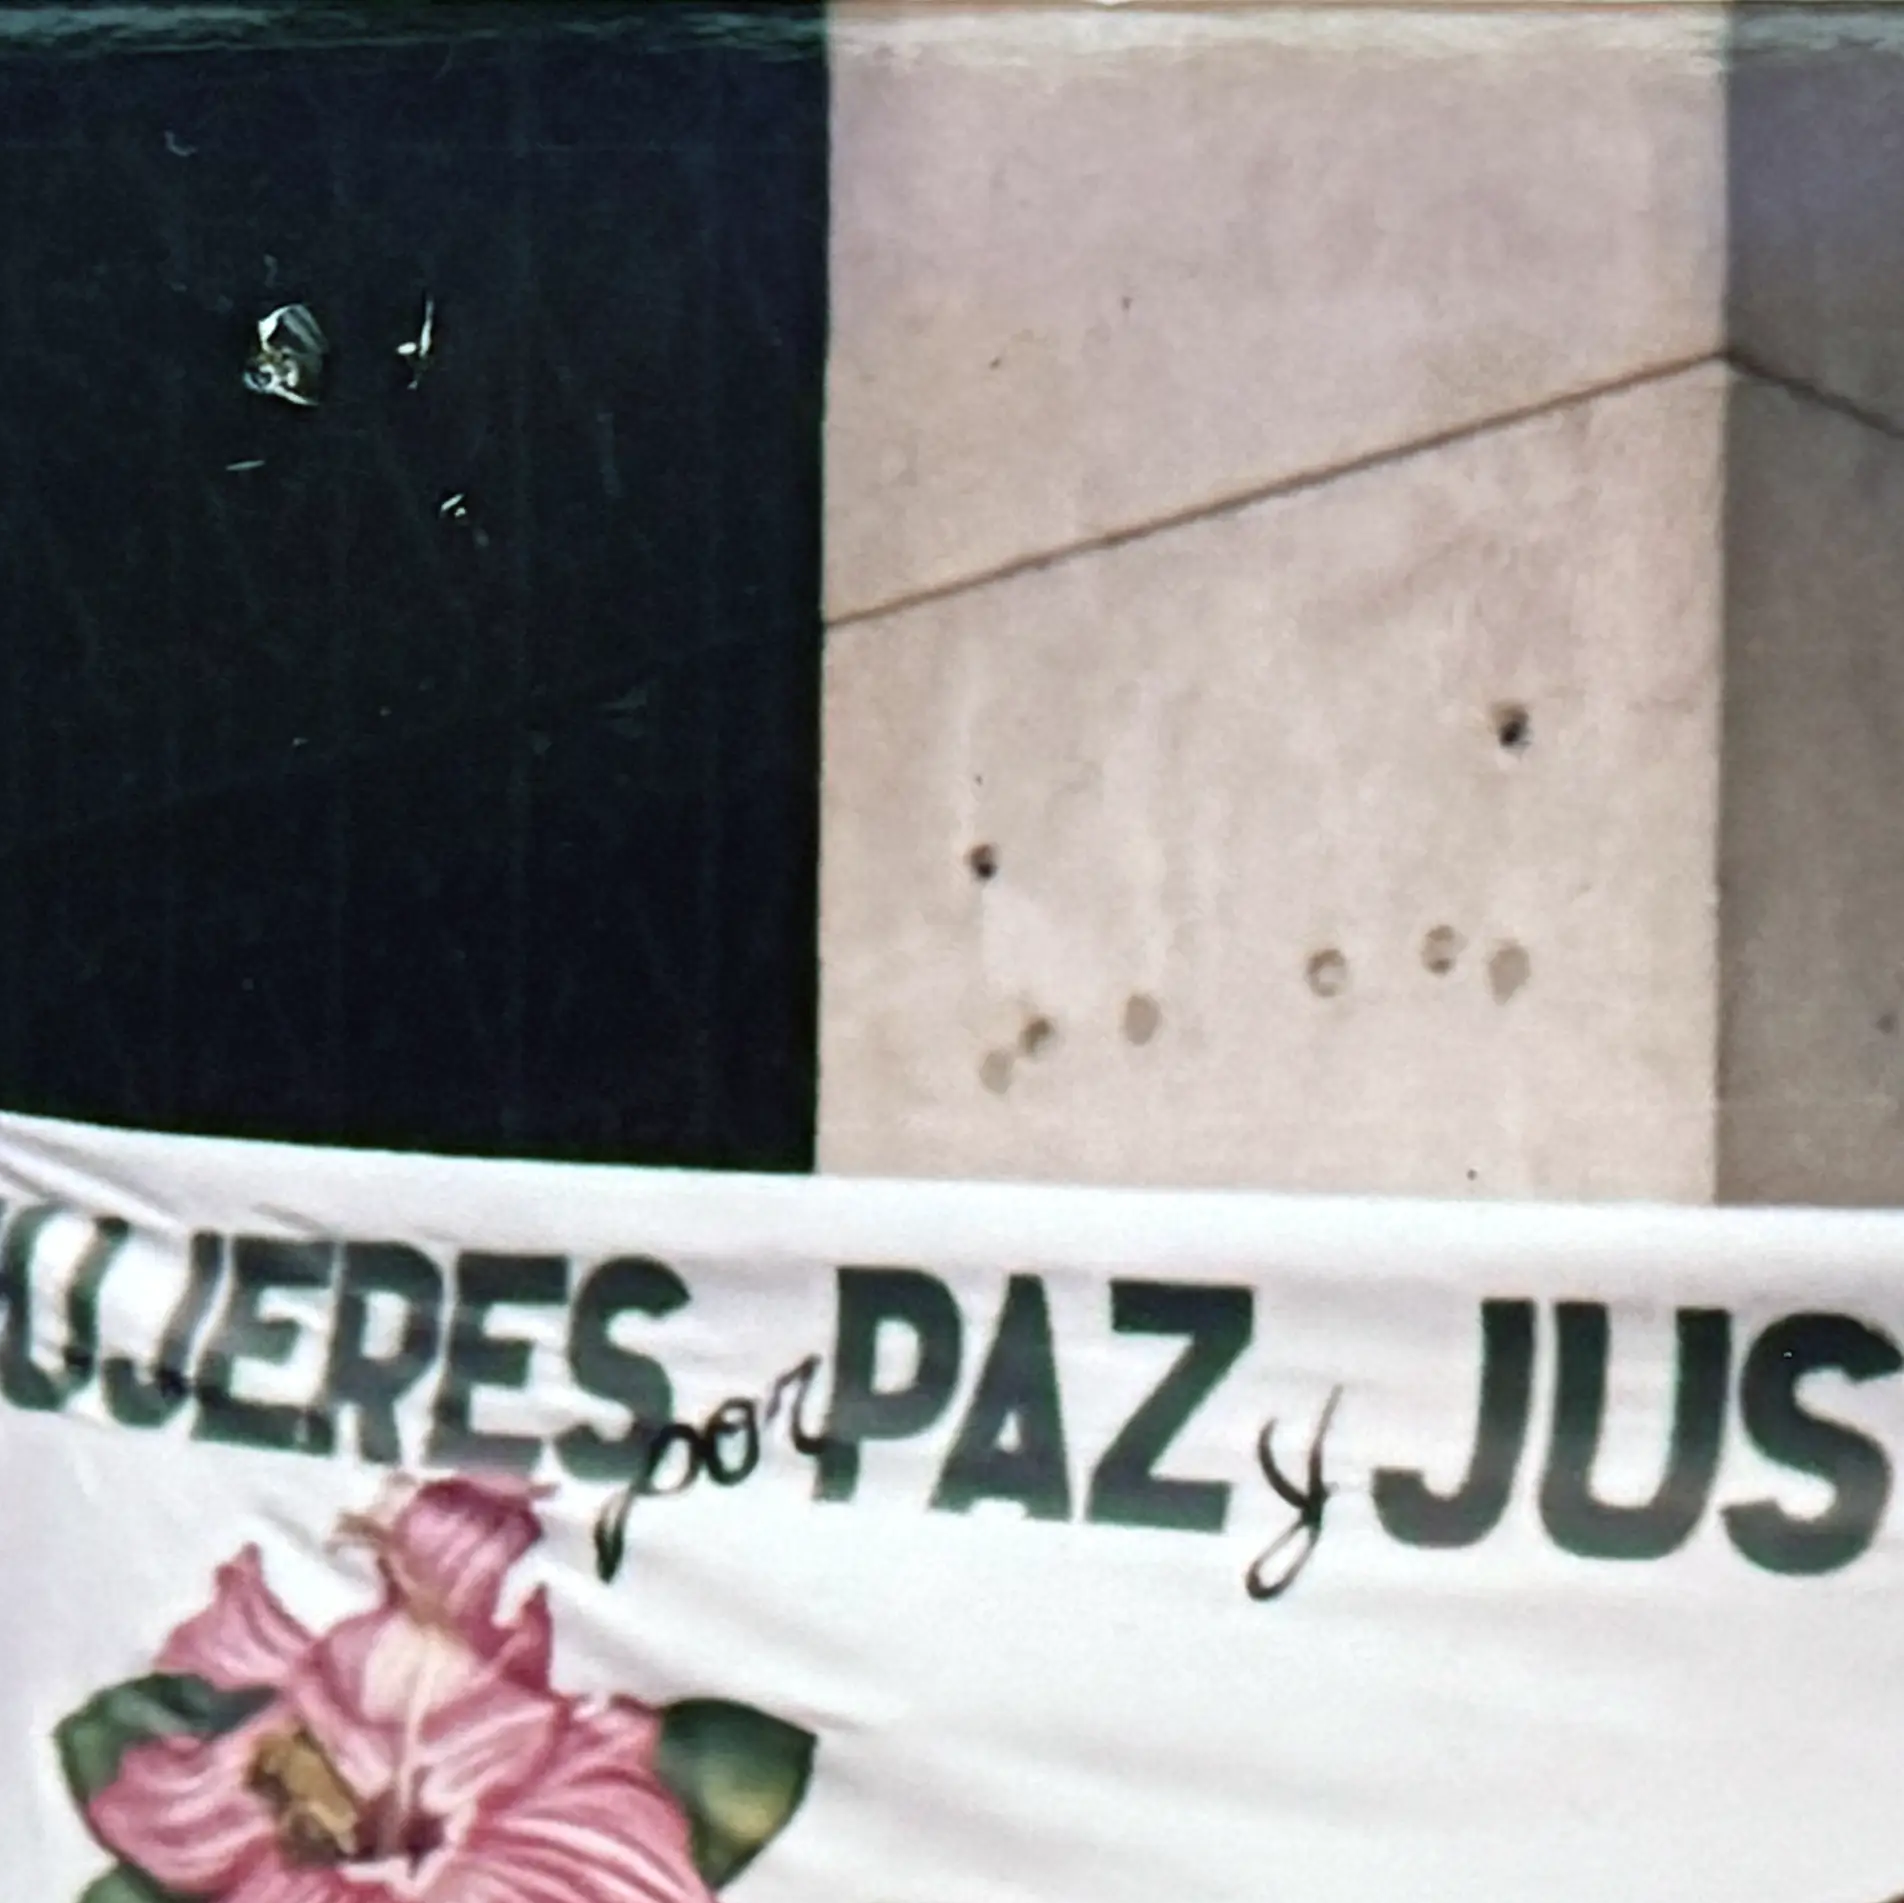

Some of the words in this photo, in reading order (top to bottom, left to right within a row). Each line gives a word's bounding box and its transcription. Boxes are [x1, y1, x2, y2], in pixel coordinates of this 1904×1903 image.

[593, 1352, 831, 1584] por
[810, 1262, 1256, 1535] PAZ
[1245, 1383, 1343, 1602] y
